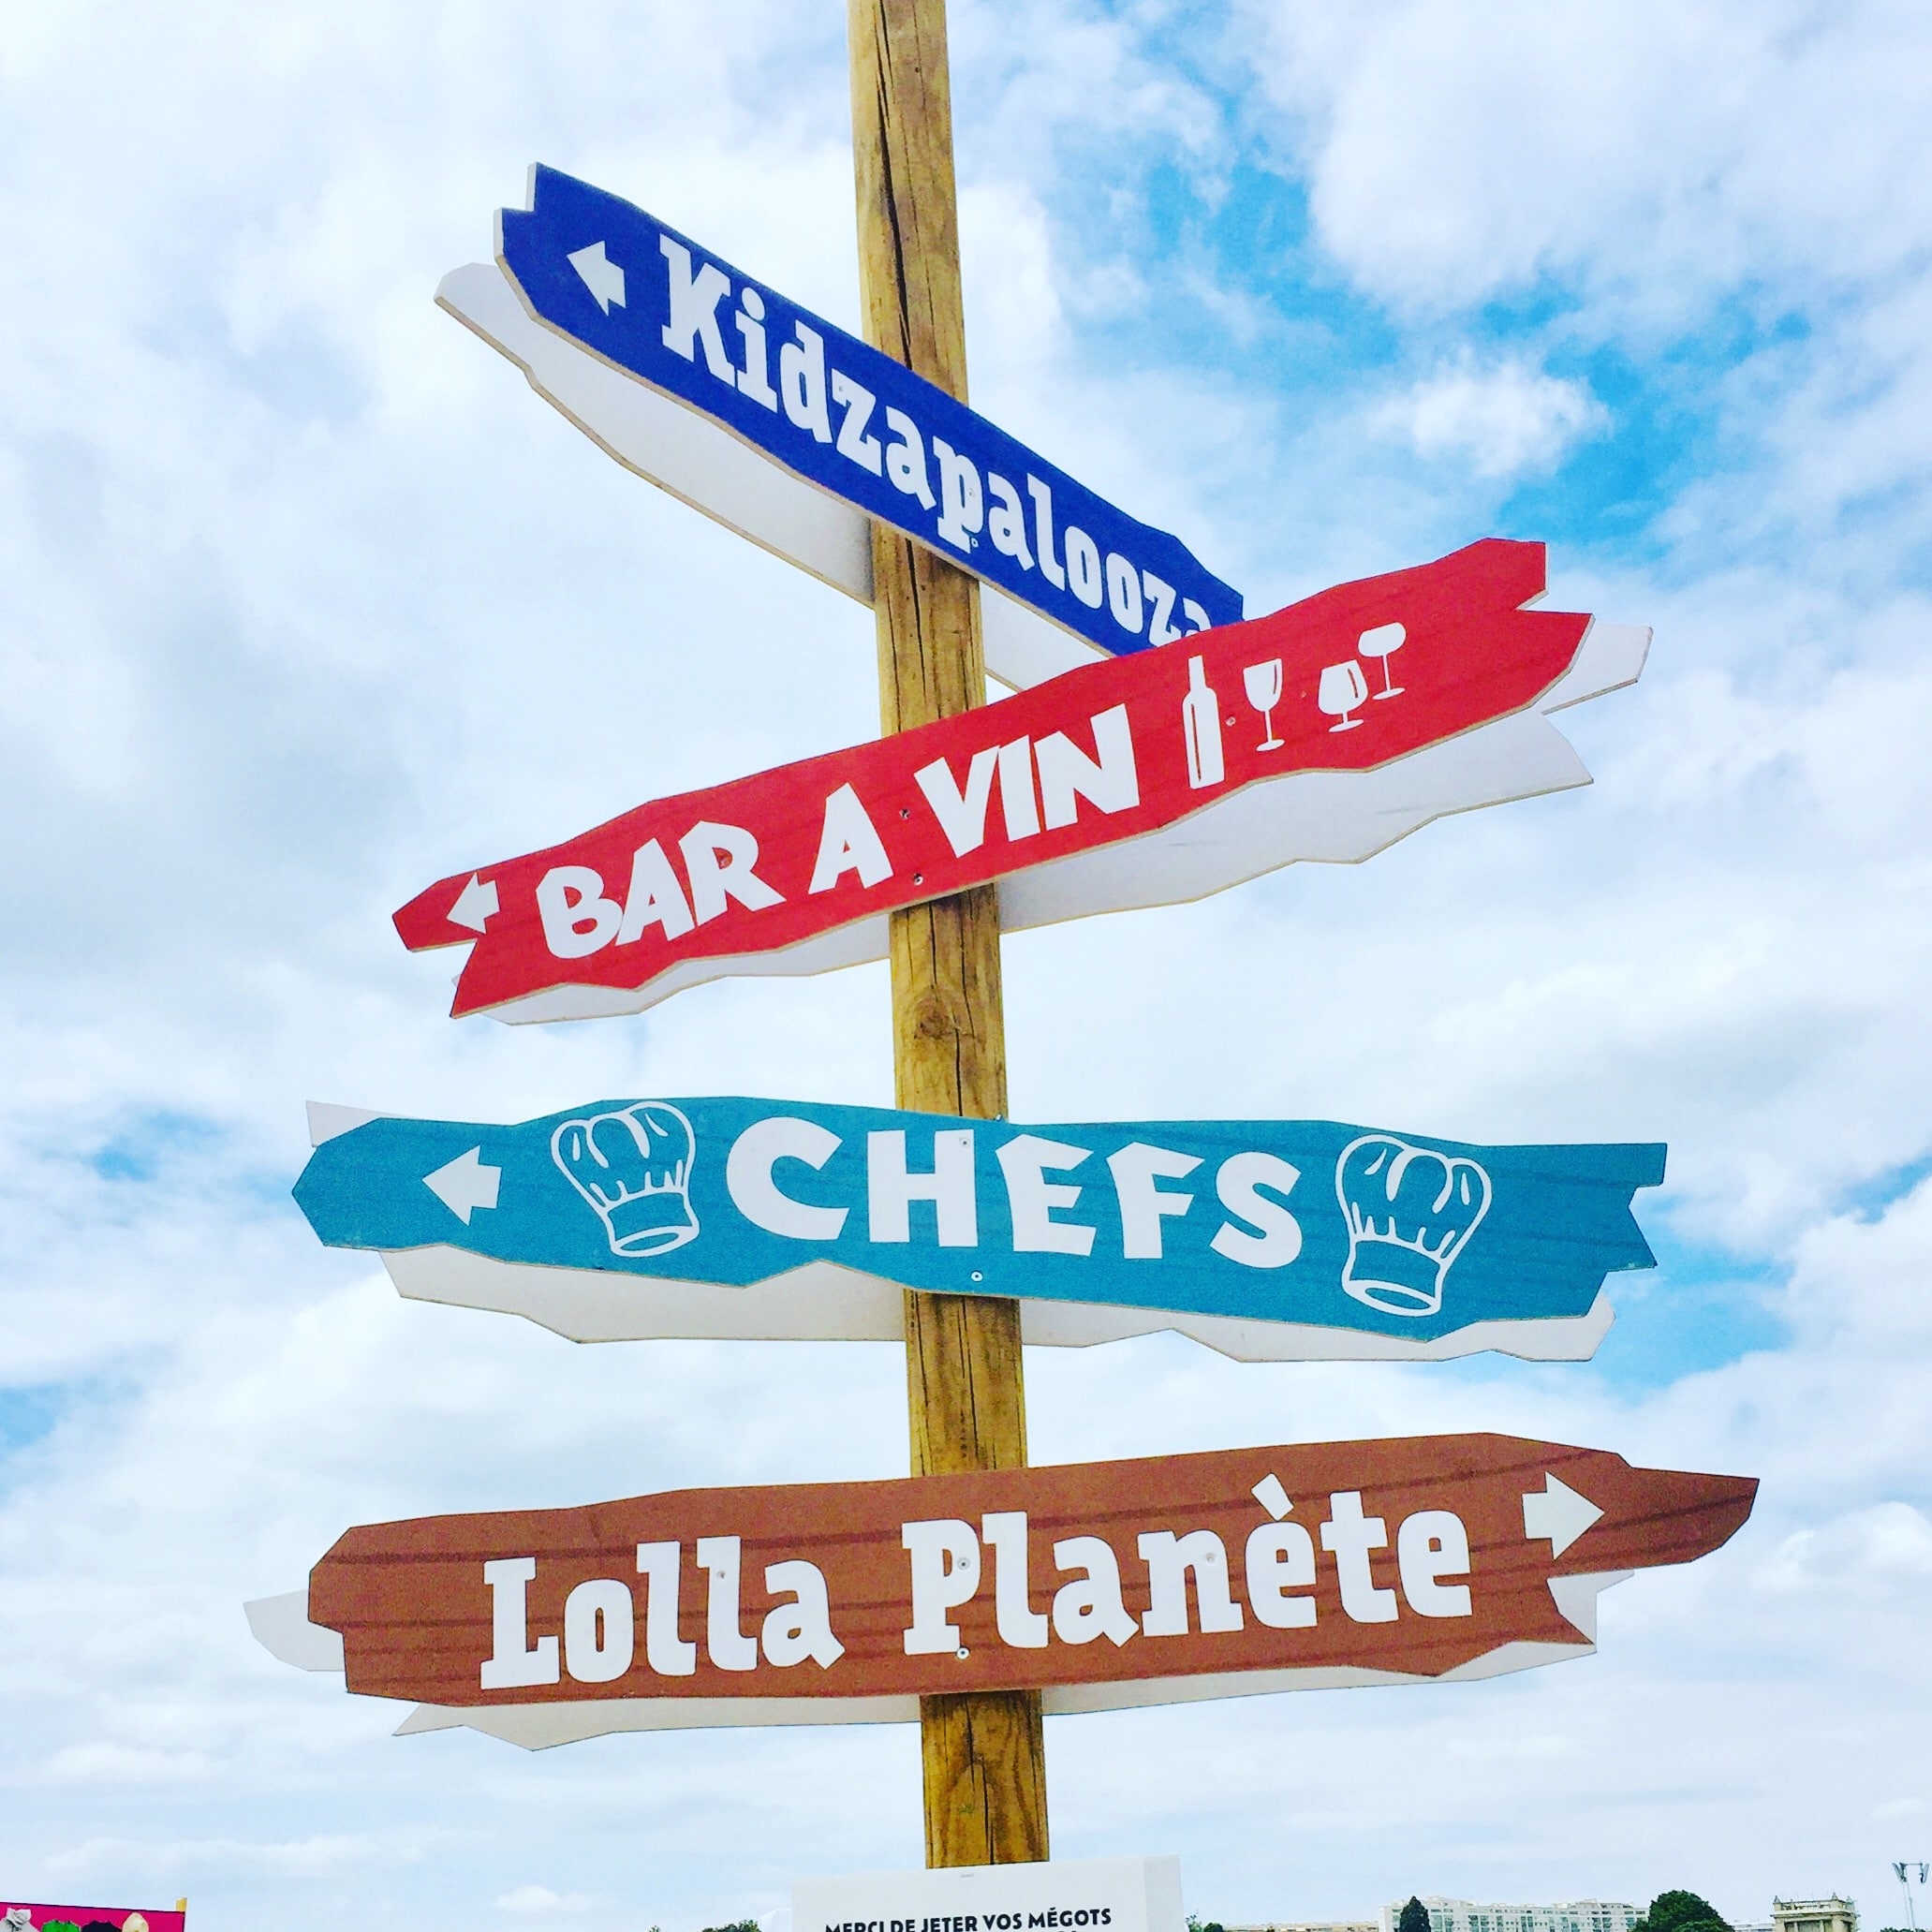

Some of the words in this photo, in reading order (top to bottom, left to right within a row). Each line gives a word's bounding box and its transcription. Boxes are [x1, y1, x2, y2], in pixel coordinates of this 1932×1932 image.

[535, 820, 787, 960] BAR
[807, 782, 894, 895] A
[913, 702, 1141, 859] VIN
[726, 1116, 1303, 1269] CHEFS
[479, 1535, 847, 1691] Lolla
[901, 1471, 1474, 1659] Planète
[891, 1919, 916, 1932] DE
[921, 1916, 978, 1932] JETER
[982, 1913, 1023, 1930] VOS
[1027, 1907, 1112, 1929] MÉGOTS
